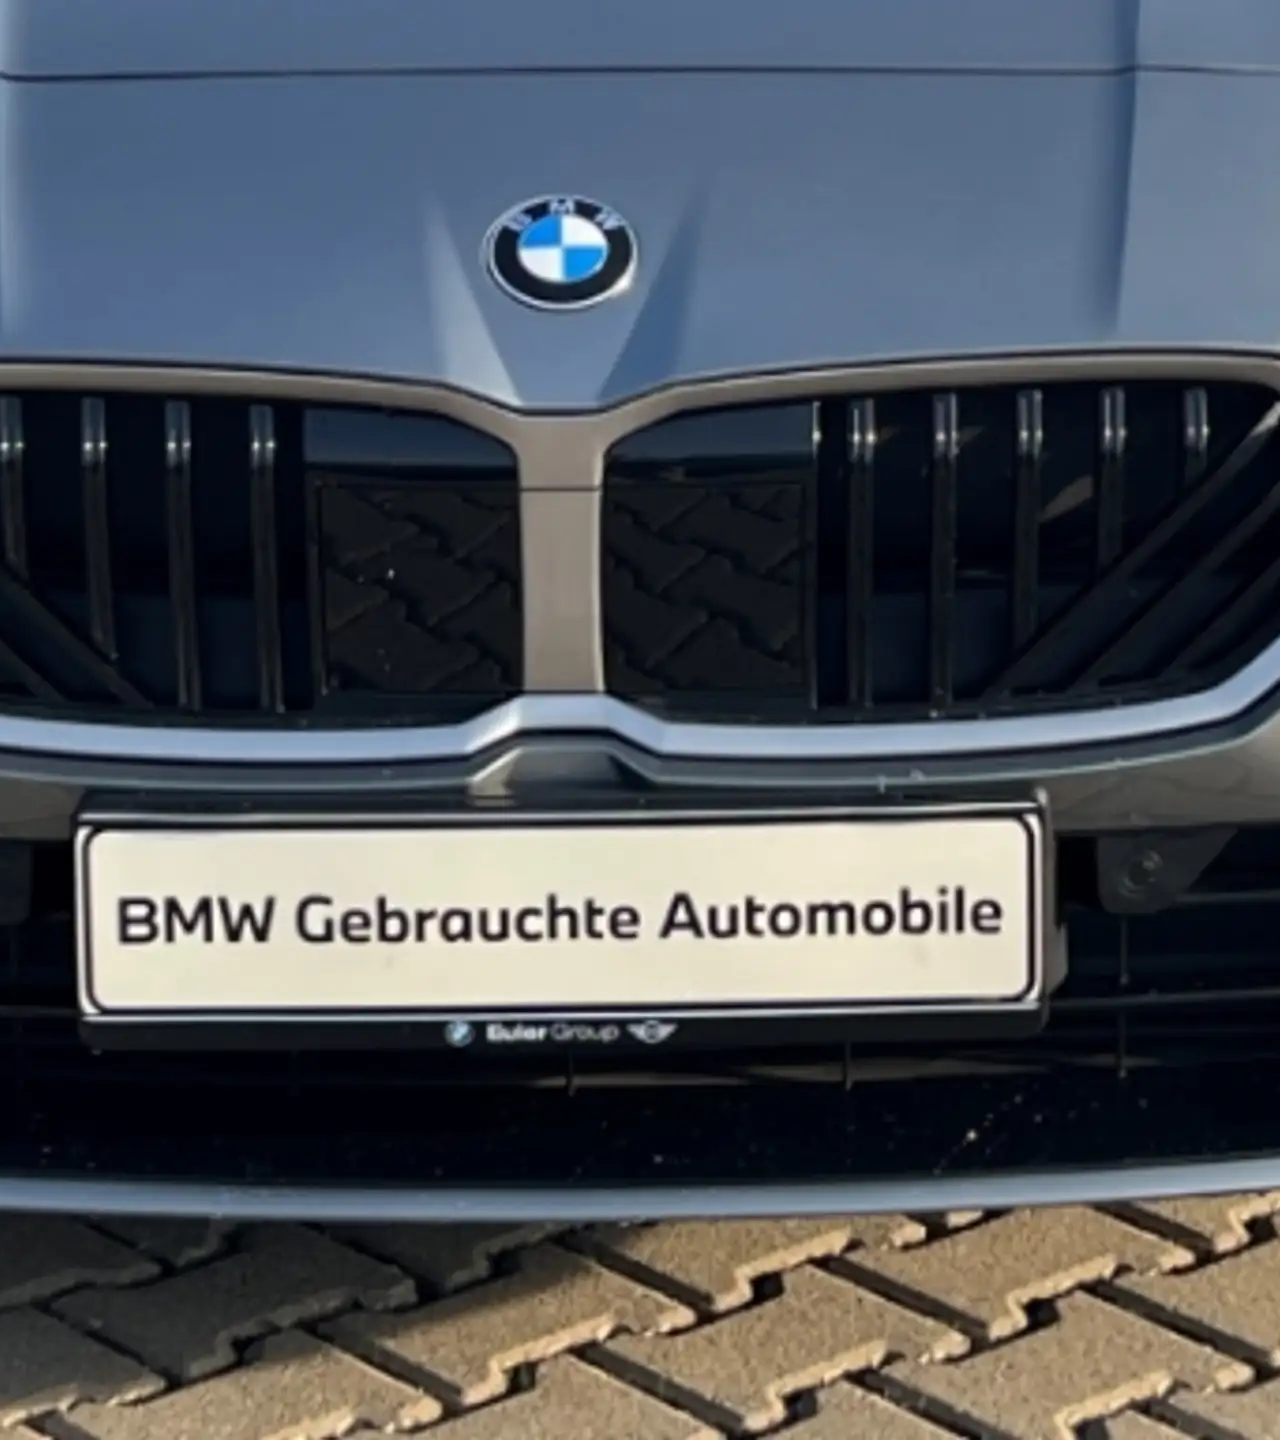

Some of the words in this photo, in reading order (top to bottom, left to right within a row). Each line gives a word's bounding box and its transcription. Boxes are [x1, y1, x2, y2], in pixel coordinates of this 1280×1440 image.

[117, 895, 276, 944] BMW
[295, 893, 641, 944] Gebrauchte
[658, 886, 1003, 940] Automobile
[549, 1022, 621, 1044] Group
